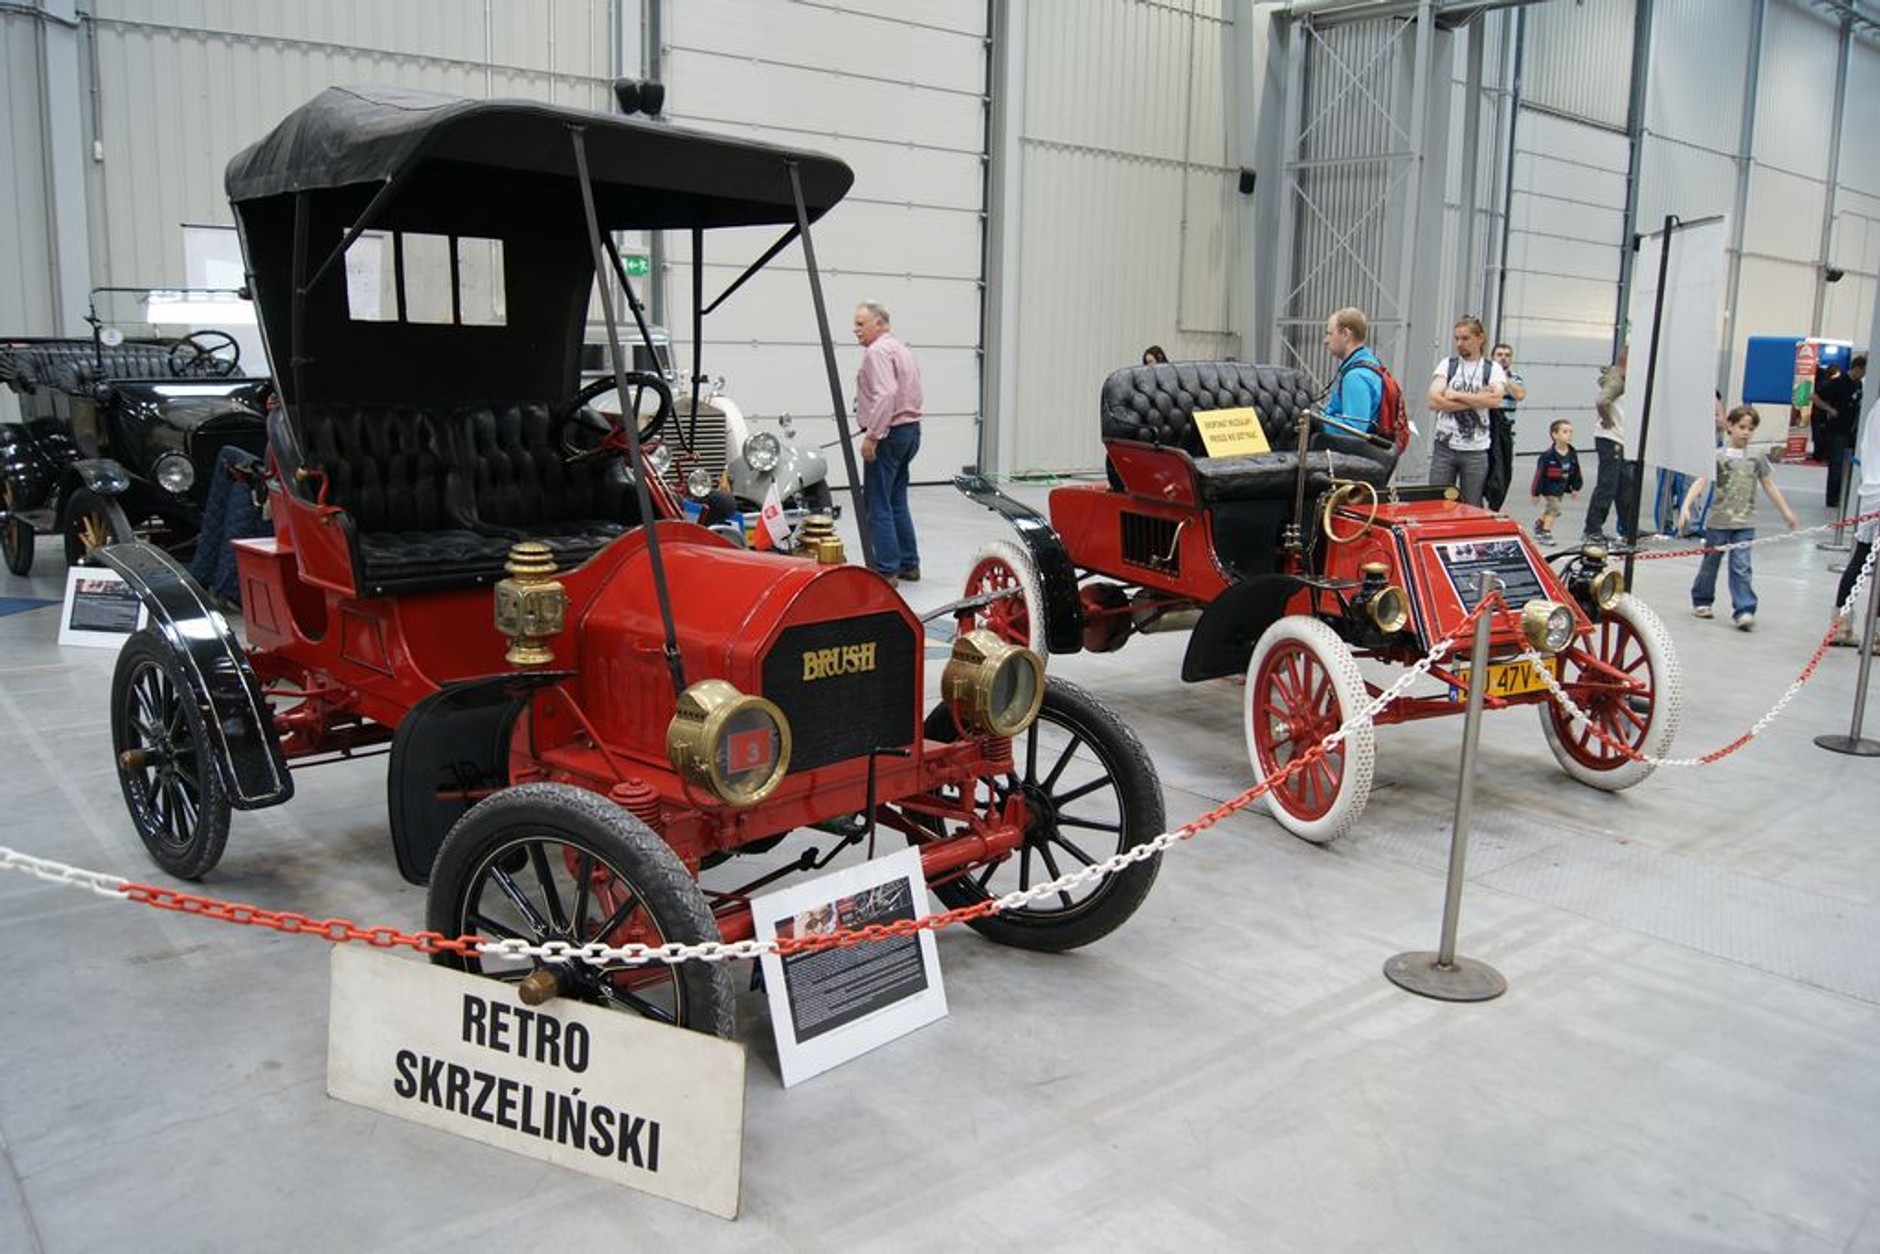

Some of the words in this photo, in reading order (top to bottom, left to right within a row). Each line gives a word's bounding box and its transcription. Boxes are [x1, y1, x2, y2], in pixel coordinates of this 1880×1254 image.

[802, 641, 877, 681] BRUSH
[1497, 663, 1532, 692] 47V
[462, 993, 590, 1074] RETRO
[393, 1049, 661, 1172] SKRZELIŃSKI
